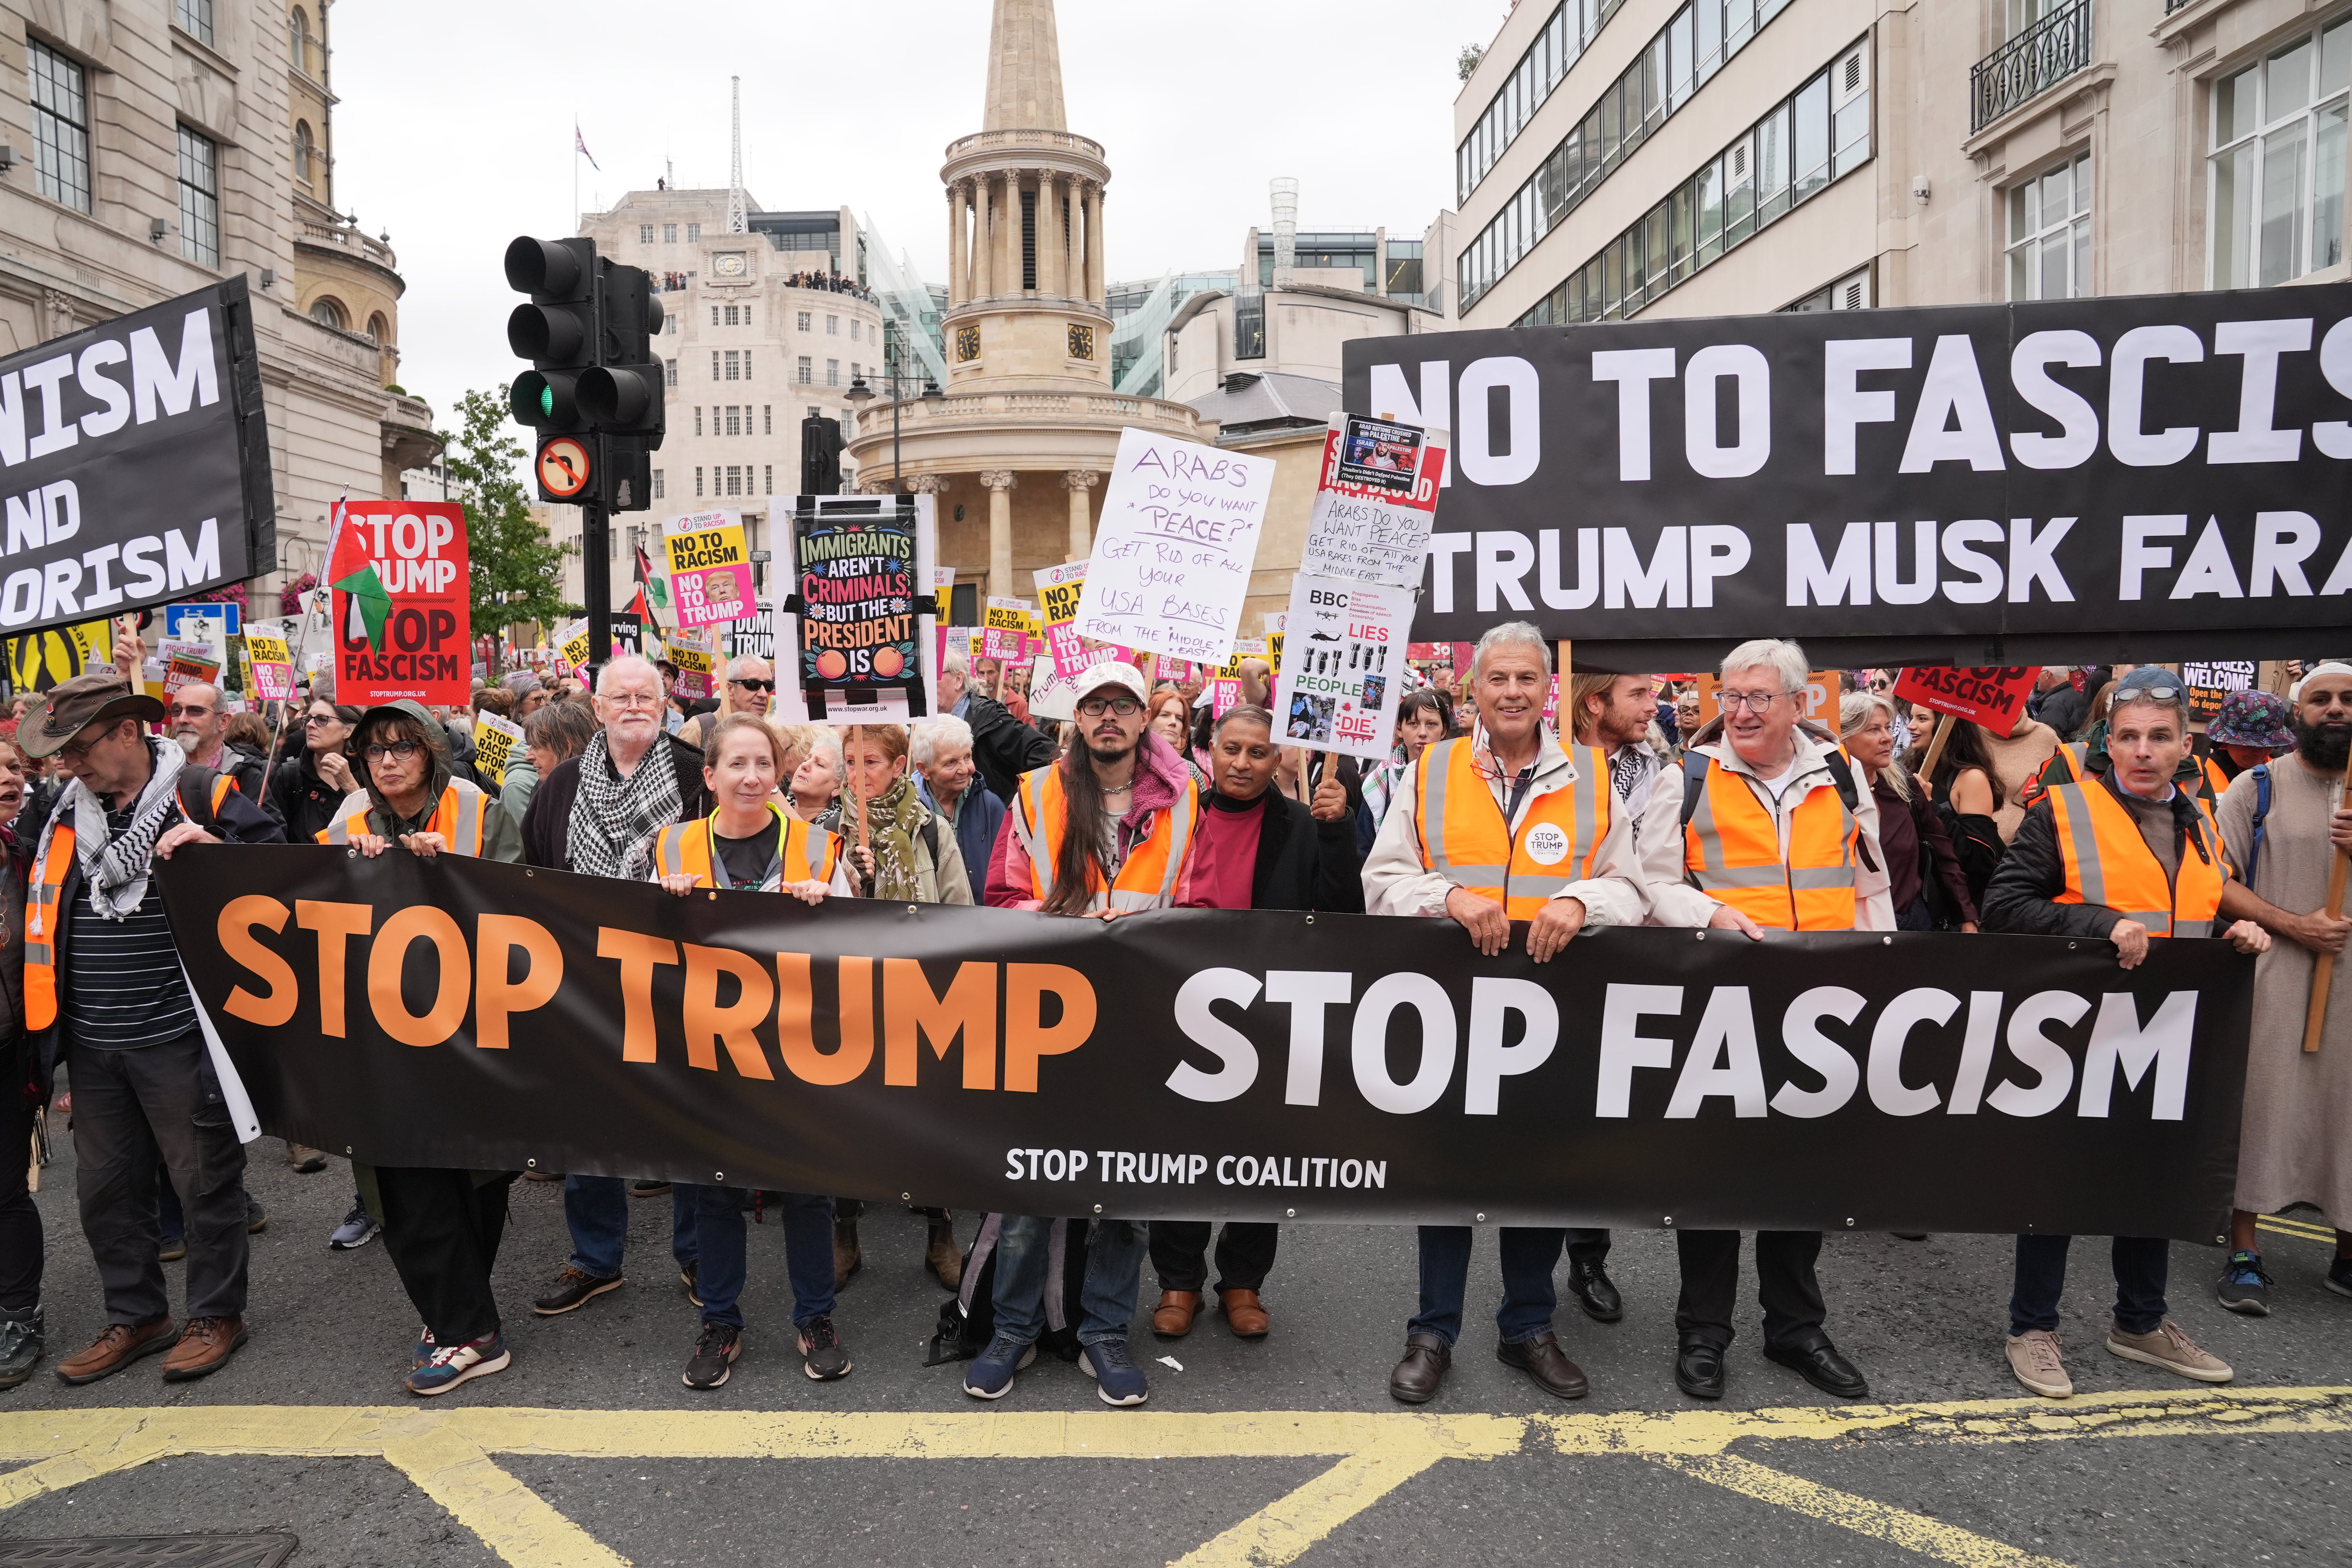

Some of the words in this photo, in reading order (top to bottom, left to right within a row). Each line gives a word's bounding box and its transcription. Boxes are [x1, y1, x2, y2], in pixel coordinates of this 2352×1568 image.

[1370, 356, 1541, 487] NO
[1592, 344, 1771, 482] TO
[1370, 431, 1401, 443] PALESTINE
[1392, 428, 1412, 437] CRUSHED
[1390, 445, 1412, 453] PALESTINE
[1131, 447, 1248, 487] ARABS
[1149, 485, 1171, 499] DO
[1221, 497, 1259, 512] WANT
[0, 479, 80, 555] ND
[703, 519, 726, 528] RACISM
[1140, 505, 1245, 542] PEACE?
[1328, 500, 1368, 521] ARABS
[1372, 509, 1390, 525] DO
[1397, 515, 1419, 531] YOU
[348, 514, 454, 559] STOP
[1324, 519, 1366, 537] WANT
[1370, 525, 1429, 548] PEACE?
[671, 536, 696, 554] NO
[699, 532, 722, 549] TO
[800, 534, 910, 566] IMMIGRANTS
[1309, 535, 1334, 546] GET
[1341, 541, 1357, 551] RID
[1401, 554, 1419, 564] YOUR
[674, 546, 738, 570] RACISM
[1102, 537, 1150, 559] GET
[1156, 543, 1183, 564] RID
[1192, 553, 1214, 568] OF
[1220, 559, 1243, 574] ALL
[1309, 548, 1326, 557] USA
[1328, 551, 1352, 563] BASES
[1357, 556, 1380, 566] FROM
[1386, 563, 1406, 573] THE
[828, 557, 885, 578] AREN'T
[1065, 565, 1082, 573] STAND
[1323, 564, 1356, 576] MIDDLE
[1358, 570, 1383, 580] EAST
[1427, 524, 1752, 613] TRUMP
[1786, 517, 2079, 607] MUSK
[678, 574, 703, 592] NO
[803, 573, 911, 603] CRIMINALS,
[680, 590, 704, 608] TO
[1045, 587, 1069, 606] NO
[1101, 587, 1144, 613] USA
[1162, 595, 1229, 624] BASES
[1310, 590, 1348, 608] BBC
[683, 600, 743, 624] TRUMP
[826, 603, 857, 622] BUT
[858, 598, 888, 616] THE
[990, 609, 1003, 618] NO
[1006, 611, 1018, 620] TO
[1351, 602, 1386, 611] Dehumanisation
[572, 623, 583, 632] STAND
[989, 618, 1024, 630] RACISM
[1349, 623, 1388, 642] LIES
[987, 630, 1001, 639] NO
[1053, 624, 1078, 643] NO
[1085, 619, 1122, 635] FROM
[1134, 626, 1161, 641] THE
[1169, 632, 1214, 650] MIDDLE
[165, 644, 185, 653] FIGHT
[250, 639, 265, 649] NO
[267, 640, 277, 650] TO
[564, 641, 581, 655] NO
[986, 639, 999, 648] TO
[1056, 639, 1080, 658] TO
[254, 650, 286, 662] RACISM
[672, 649, 684, 659] NO
[687, 652, 699, 662] TO
[849, 649, 870, 673] IS
[985, 648, 1018, 660] TRUMP
[1060, 647, 1118, 673] TRUMP
[256, 664, 272, 675] NO
[345, 654, 458, 681] FASCISM
[672, 657, 706, 672] RACISM
[1159, 661, 1170, 670] TO
[258, 675, 274, 686] TO
[1158, 669, 1185, 680] TRUMP
[2184, 667, 2253, 691] WELCOME
[261, 686, 292, 698] TRUMP
[675, 686, 706, 699] TRUMP
[1219, 682, 1237, 694] NO
[1296, 675, 1363, 697] PEOPLE
[1910, 667, 2015, 715] FASCISM
[2189, 687, 2208, 699] Open
[2210, 690, 2222, 699] the
[1218, 694, 1235, 706] TO
[1929, 698, 1976, 715] STOPTRUMP.ORG.UK
[2189, 698, 2199, 708] No
[501, 727, 514, 735] RACISM
[1341, 716, 1371, 733] DIE
[486, 729, 512, 747] STOP
[485, 766, 498, 780] UK
[218, 895, 564, 1049] STOP
[597, 926, 1097, 1093] TRUMP
[1165, 967, 1559, 1115] STOP
[1595, 983, 2199, 1121] FASCISM
[1005, 1148, 1088, 1181] STOP
[1097, 1151, 1208, 1184] TRUMP
[1216, 1155, 1387, 1188] COALITION
